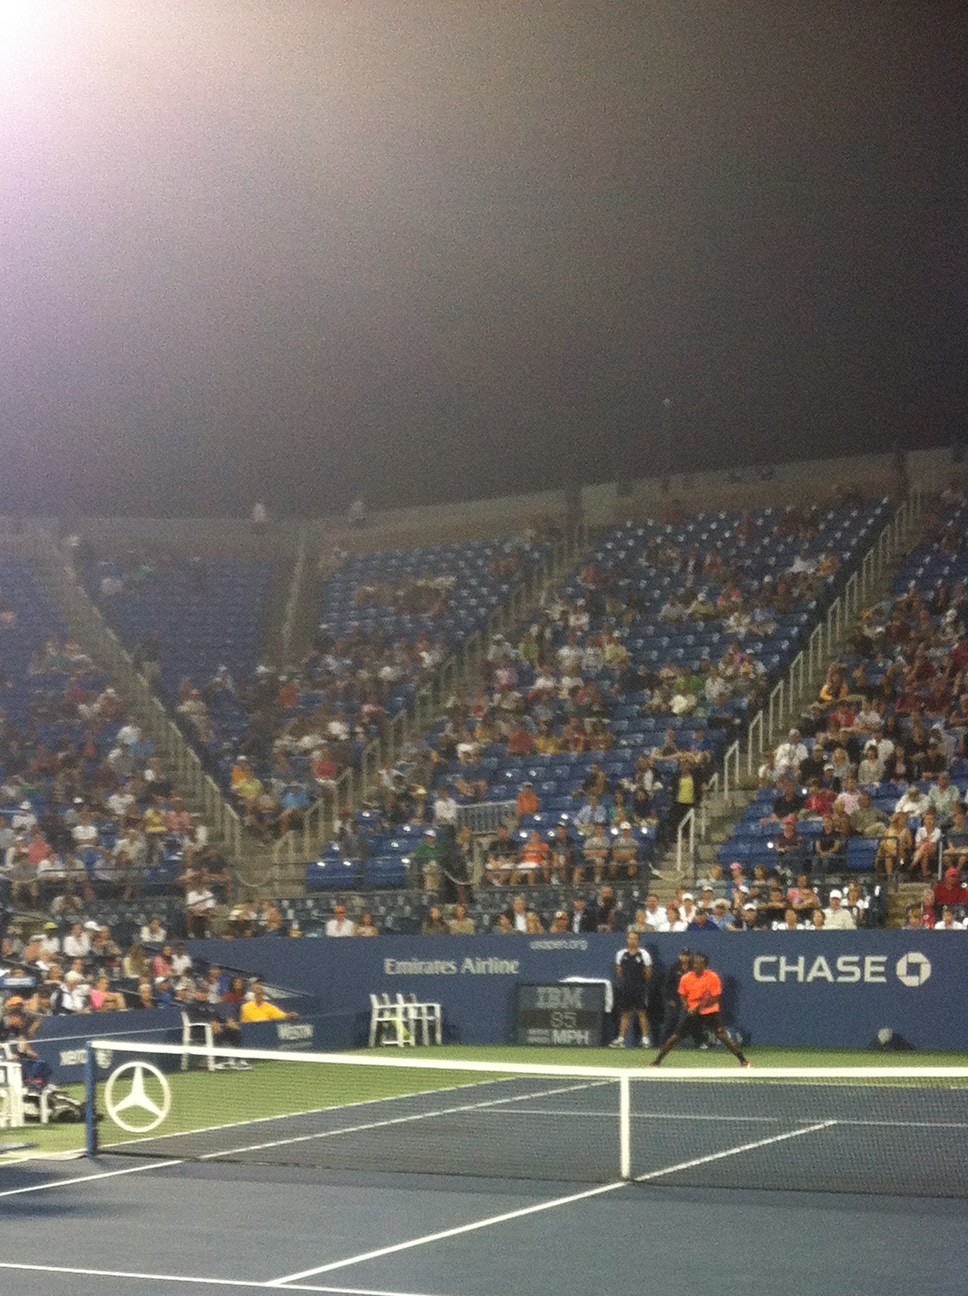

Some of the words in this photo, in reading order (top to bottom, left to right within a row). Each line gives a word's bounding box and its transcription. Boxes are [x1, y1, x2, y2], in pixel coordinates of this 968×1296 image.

[384, 957, 457, 975] Emirates
[753, 955, 888, 983] CHASE
[535, 986, 584, 1009] IBM
[552, 1029, 590, 1045] MPH
